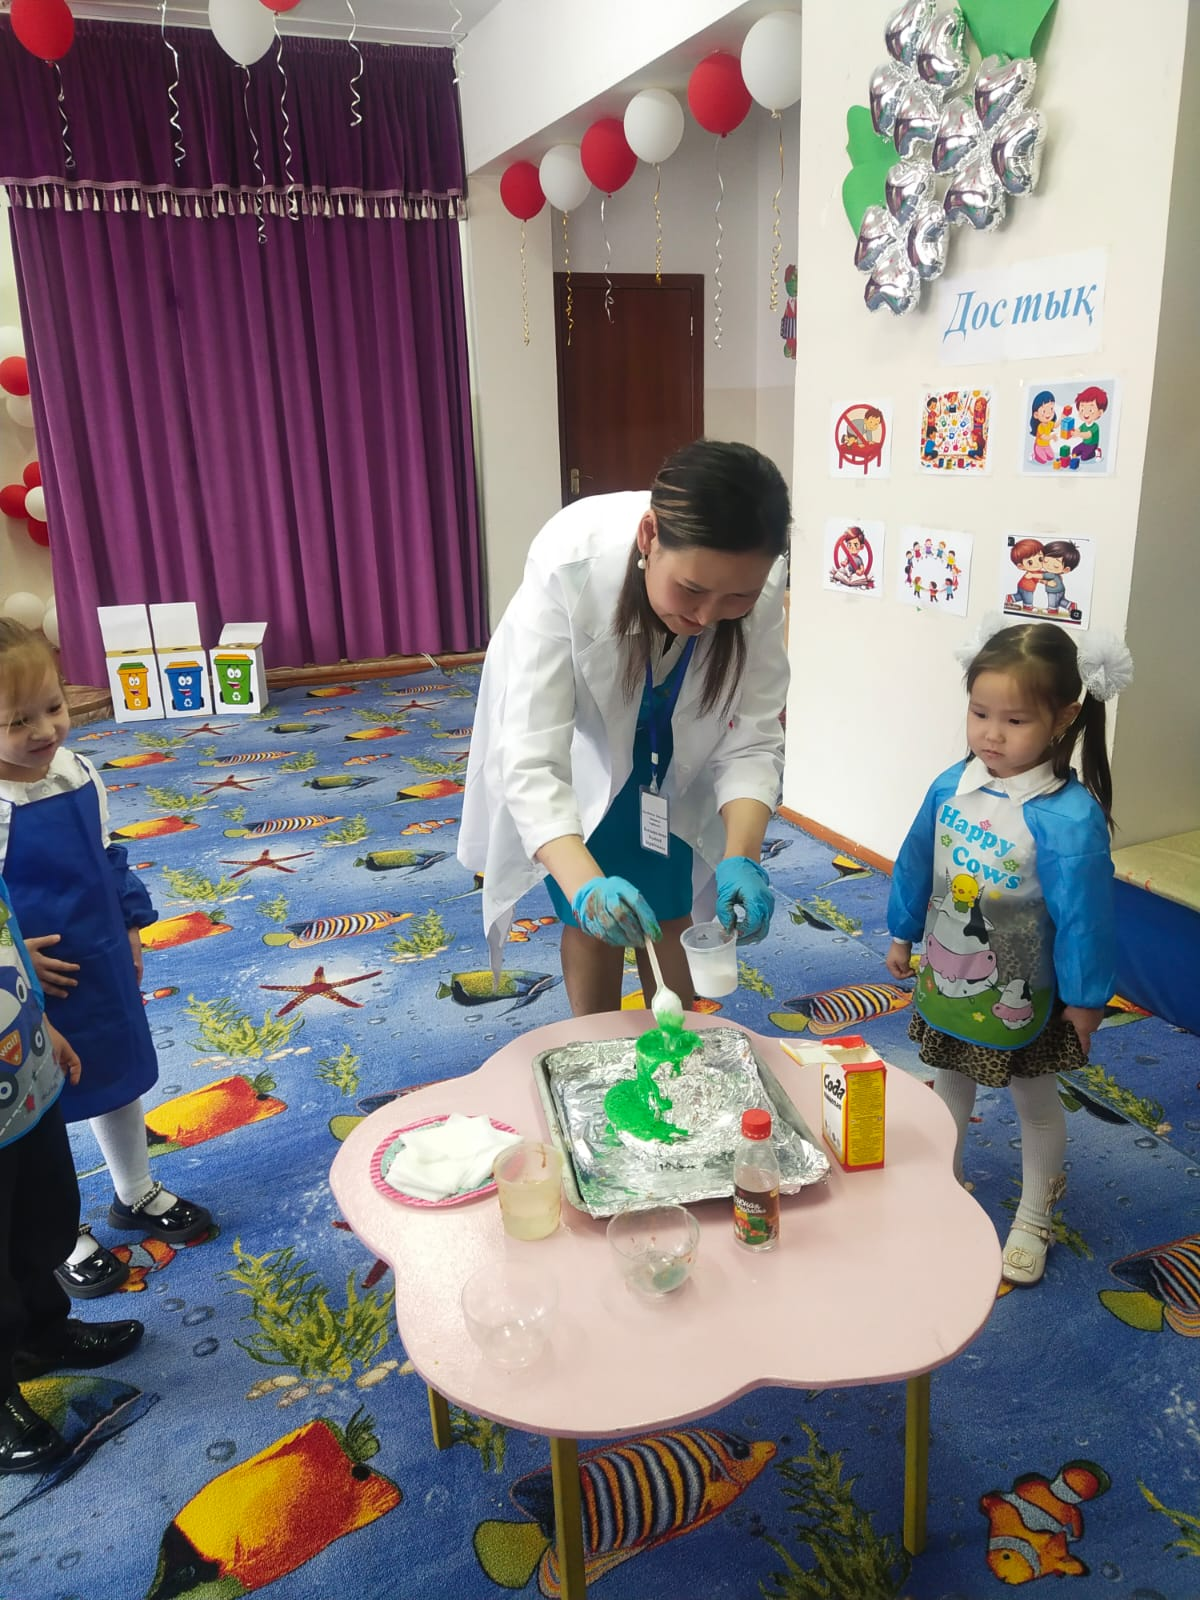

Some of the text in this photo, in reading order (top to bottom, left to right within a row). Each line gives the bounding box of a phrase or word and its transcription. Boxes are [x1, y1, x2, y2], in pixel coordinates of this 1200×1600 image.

[942, 284, 1097, 343] Достық
[939, 804, 1016, 858] Happy
[952, 846, 1021, 889] Cows
